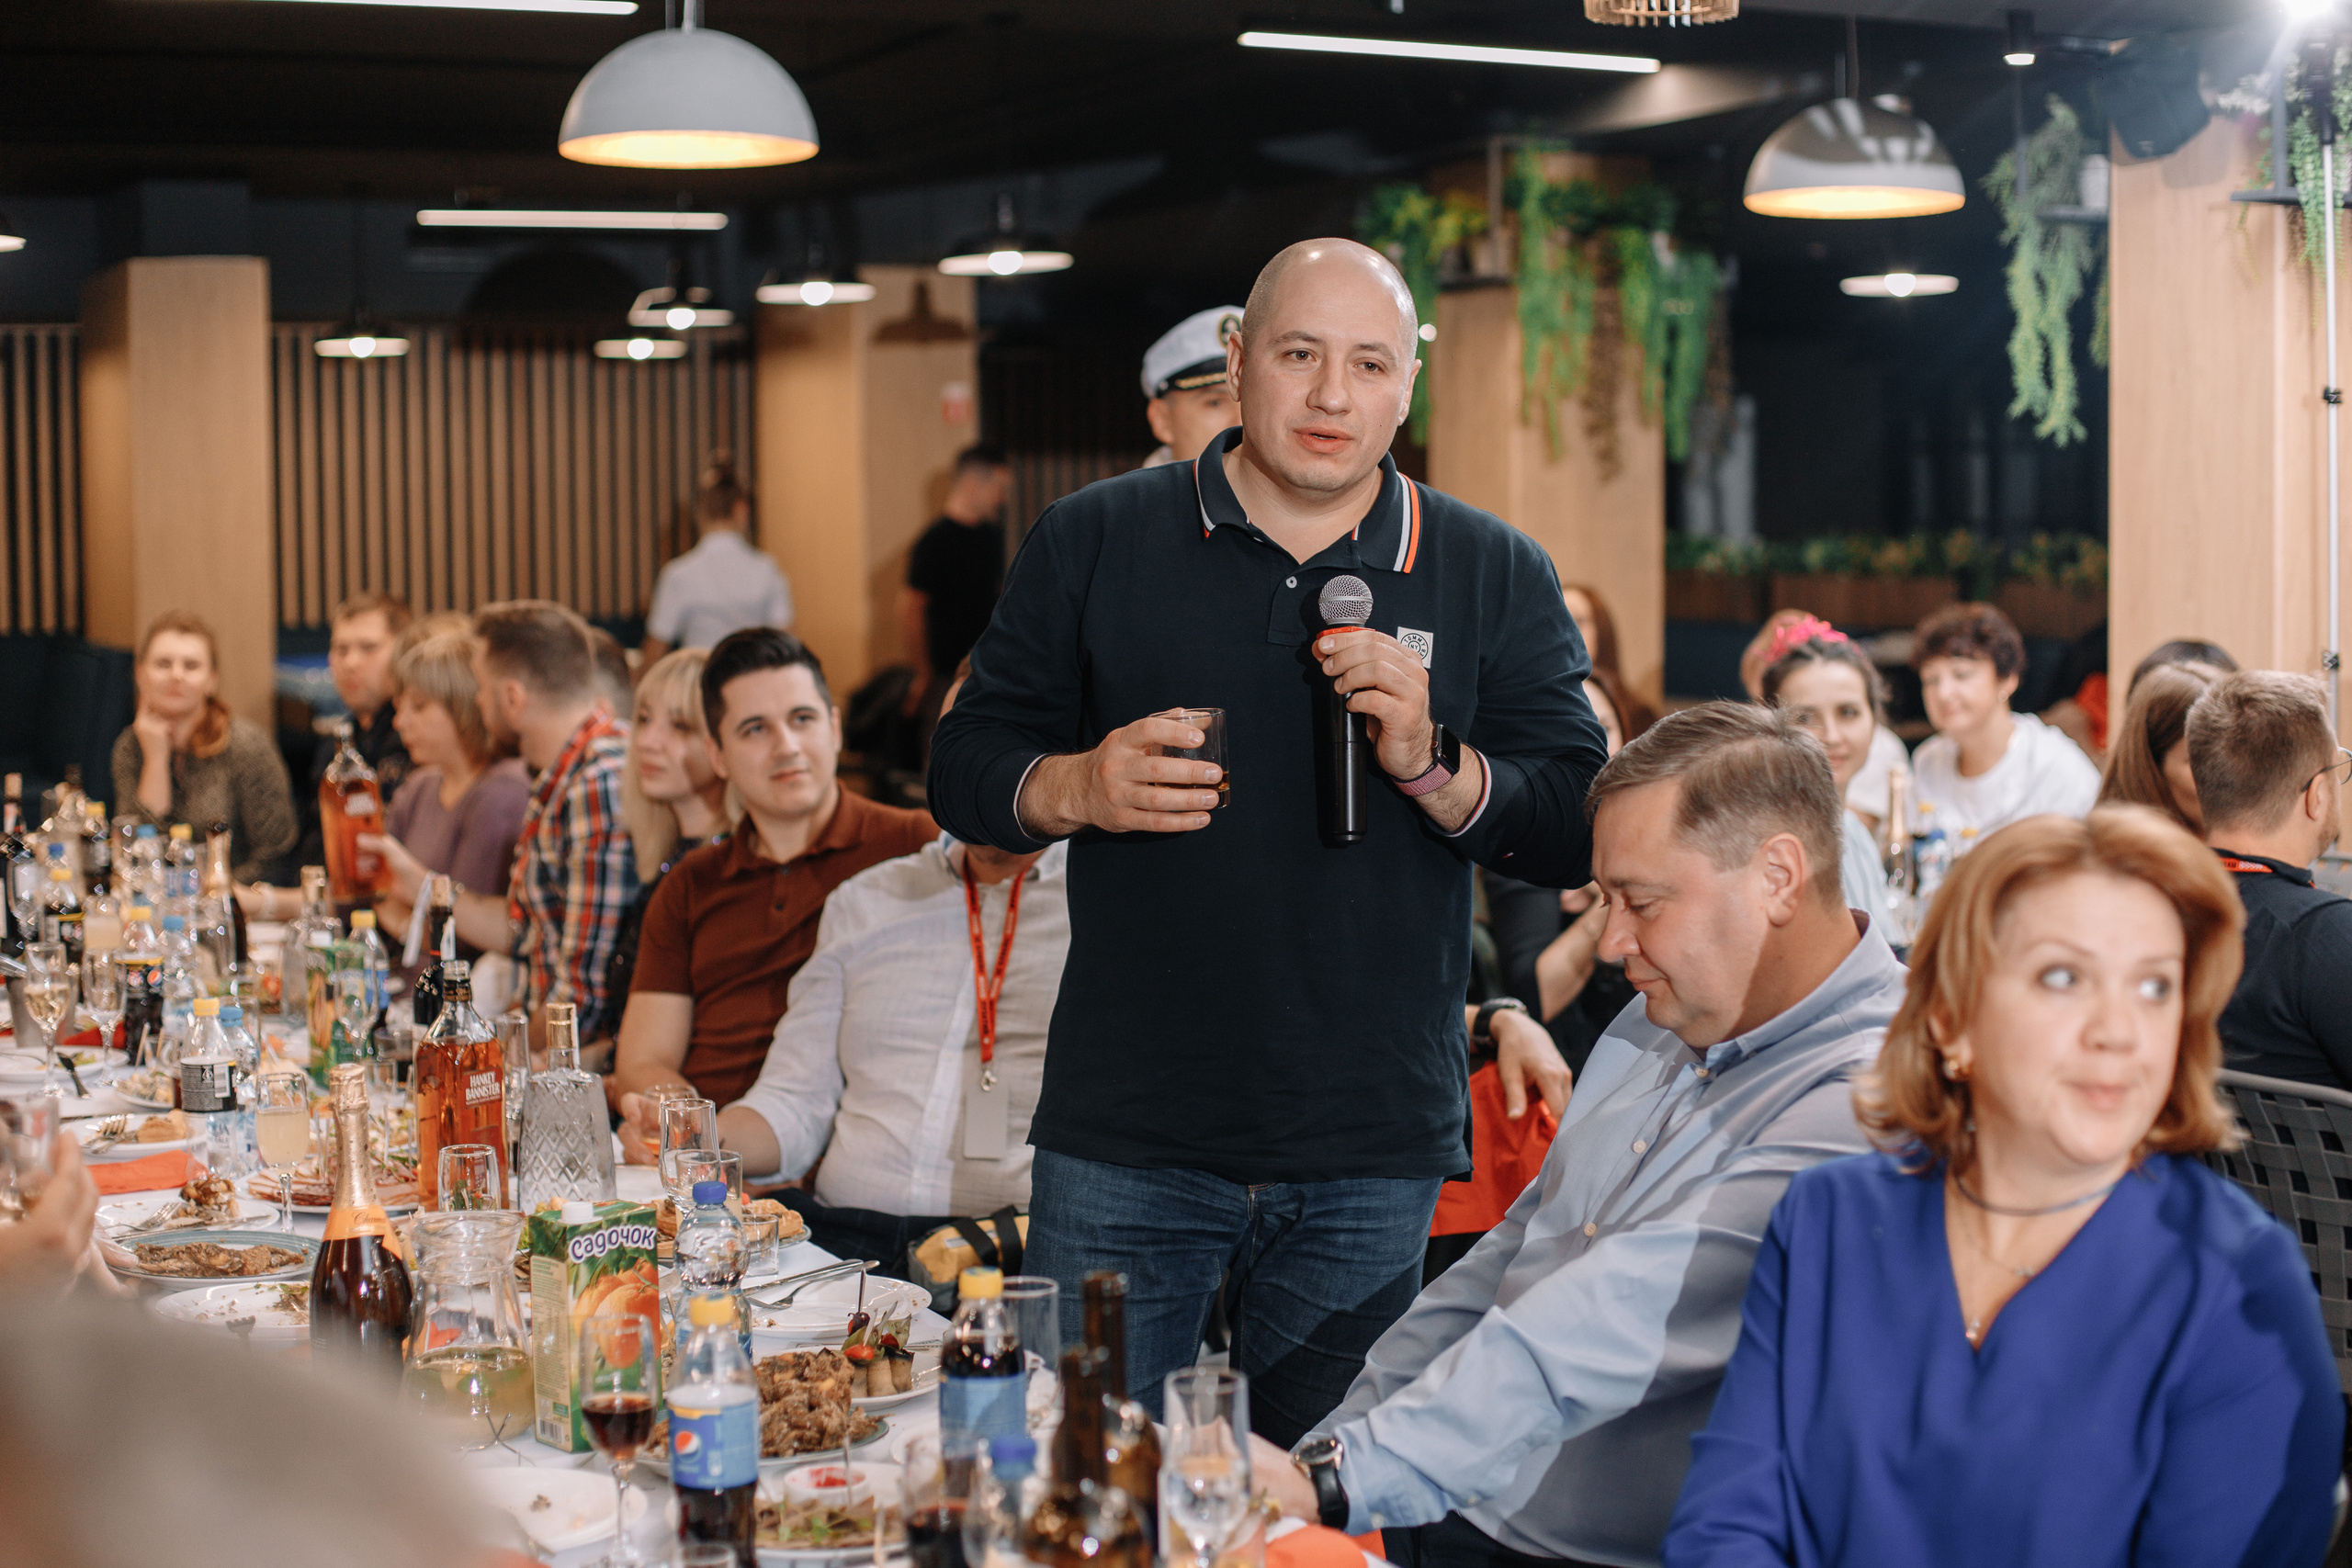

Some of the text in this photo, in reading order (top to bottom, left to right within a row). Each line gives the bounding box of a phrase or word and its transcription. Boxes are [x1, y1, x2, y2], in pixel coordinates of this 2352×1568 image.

[1404, 636, 1426, 646] TOMMY
[470, 1071, 495, 1088] HANKEY
[465, 1081, 501, 1101] BANNISTER
[571, 1225, 656, 1262] Садочок
